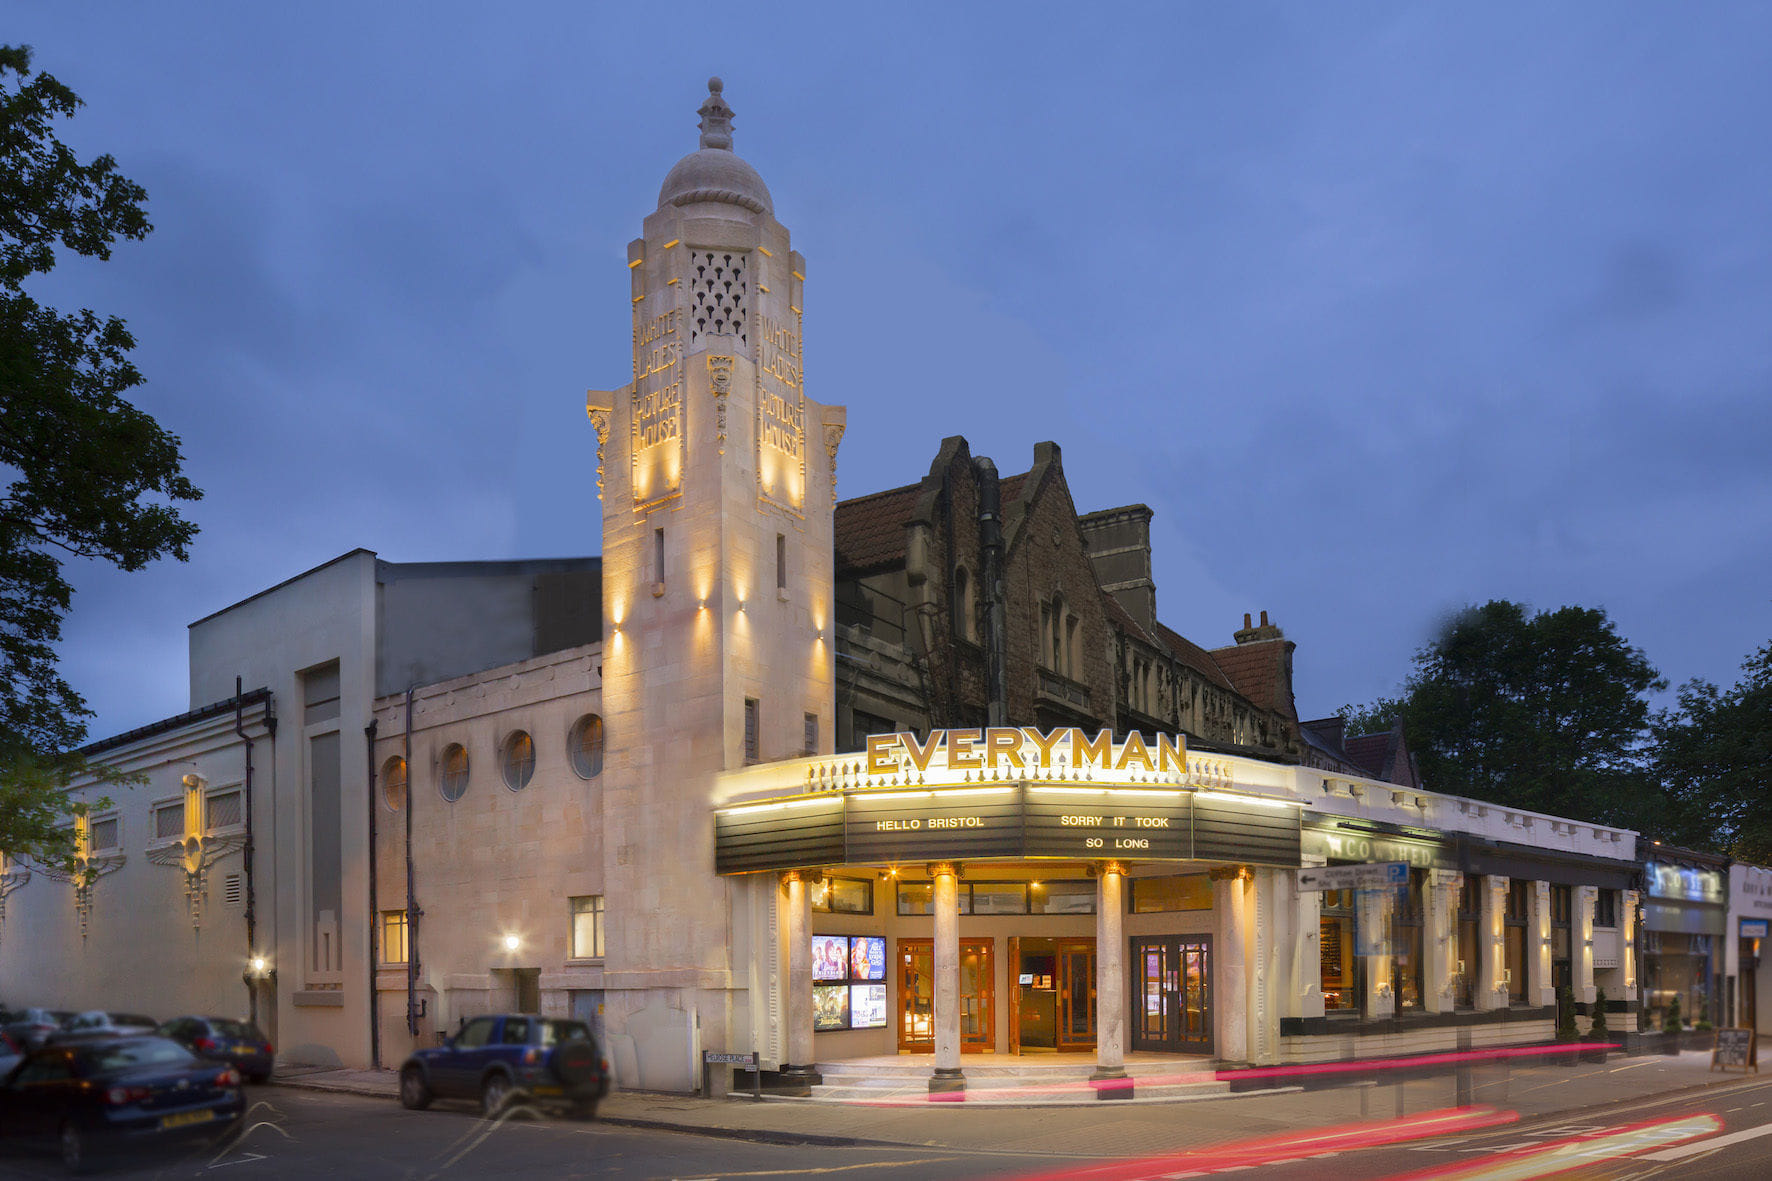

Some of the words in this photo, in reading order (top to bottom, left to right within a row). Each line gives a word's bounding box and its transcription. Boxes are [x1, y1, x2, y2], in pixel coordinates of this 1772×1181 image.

[761, 315, 798, 358] WHITE
[762, 345, 797, 388] LADIES
[640, 415, 677, 451] HOUSE
[761, 420, 798, 460] HOUSE
[866, 726, 1187, 775] EVERYMAN
[876, 819, 920, 831] HELLO
[928, 816, 984, 829] BRISTOL
[1061, 815, 1103, 826] SORRY
[1113, 816, 1126, 826] IT
[1135, 817, 1169, 828] TOOK
[1086, 838, 1104, 848] SO
[1115, 838, 1149, 849] LONG
